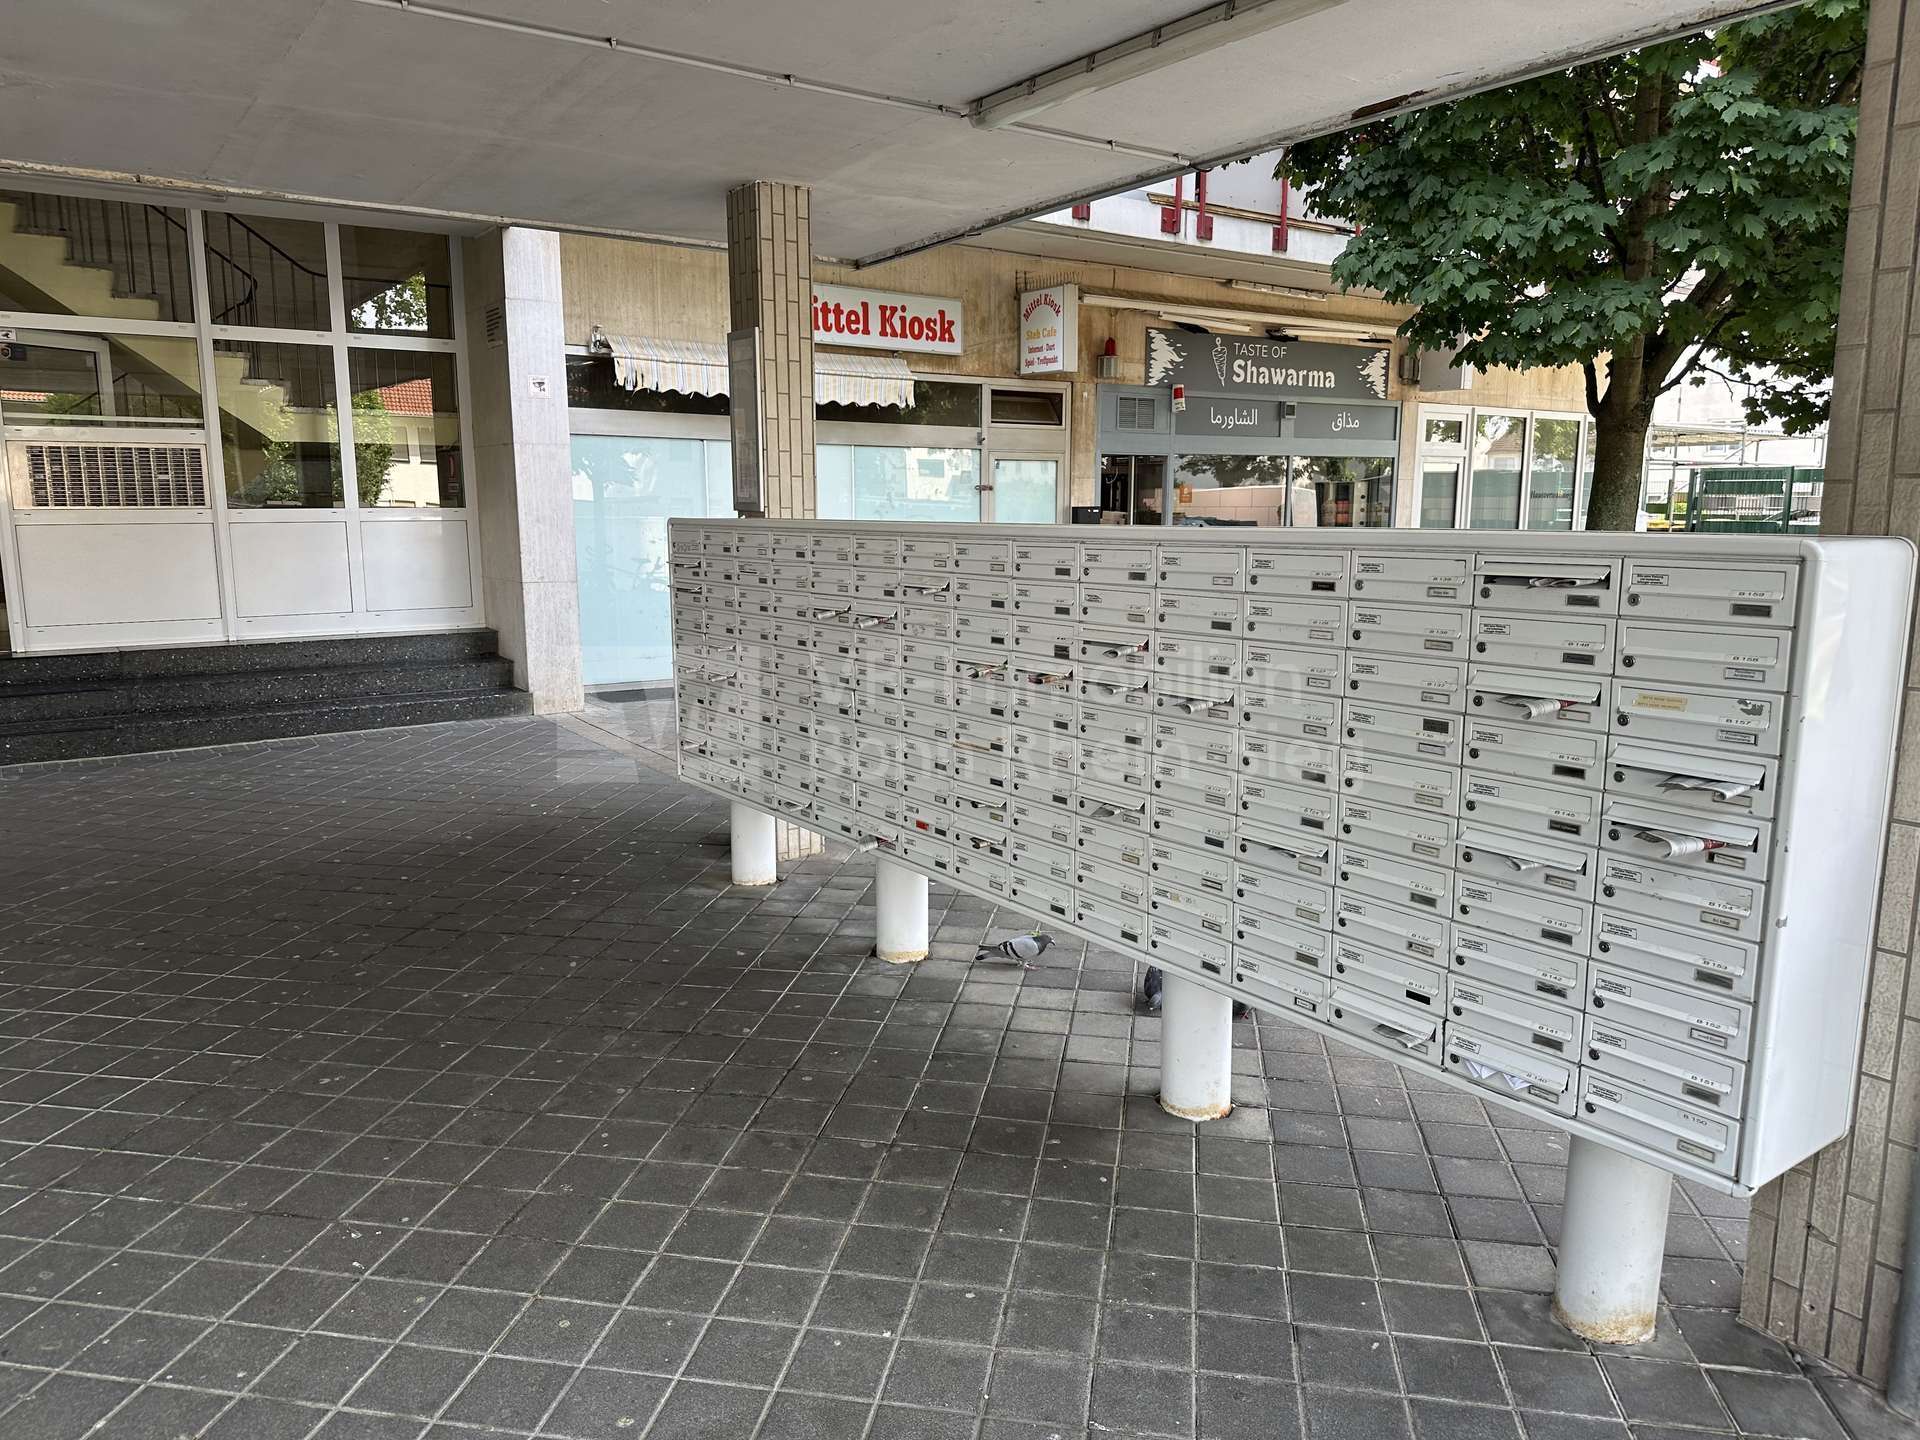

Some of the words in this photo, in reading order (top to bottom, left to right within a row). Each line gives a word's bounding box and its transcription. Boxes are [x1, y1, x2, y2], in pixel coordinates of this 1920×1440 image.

[1043, 293, 1061, 318] Kiosk
[812, 295, 871, 336] ittel
[878, 304, 956, 343] Kiosk
[1233, 342, 1269, 358] TASTE
[1272, 345, 1287, 359] OF
[1232, 359, 1336, 389] Shawarma
[1210, 406, 1259, 431] الشاورما
[1332, 411, 1360, 432] مذاق
